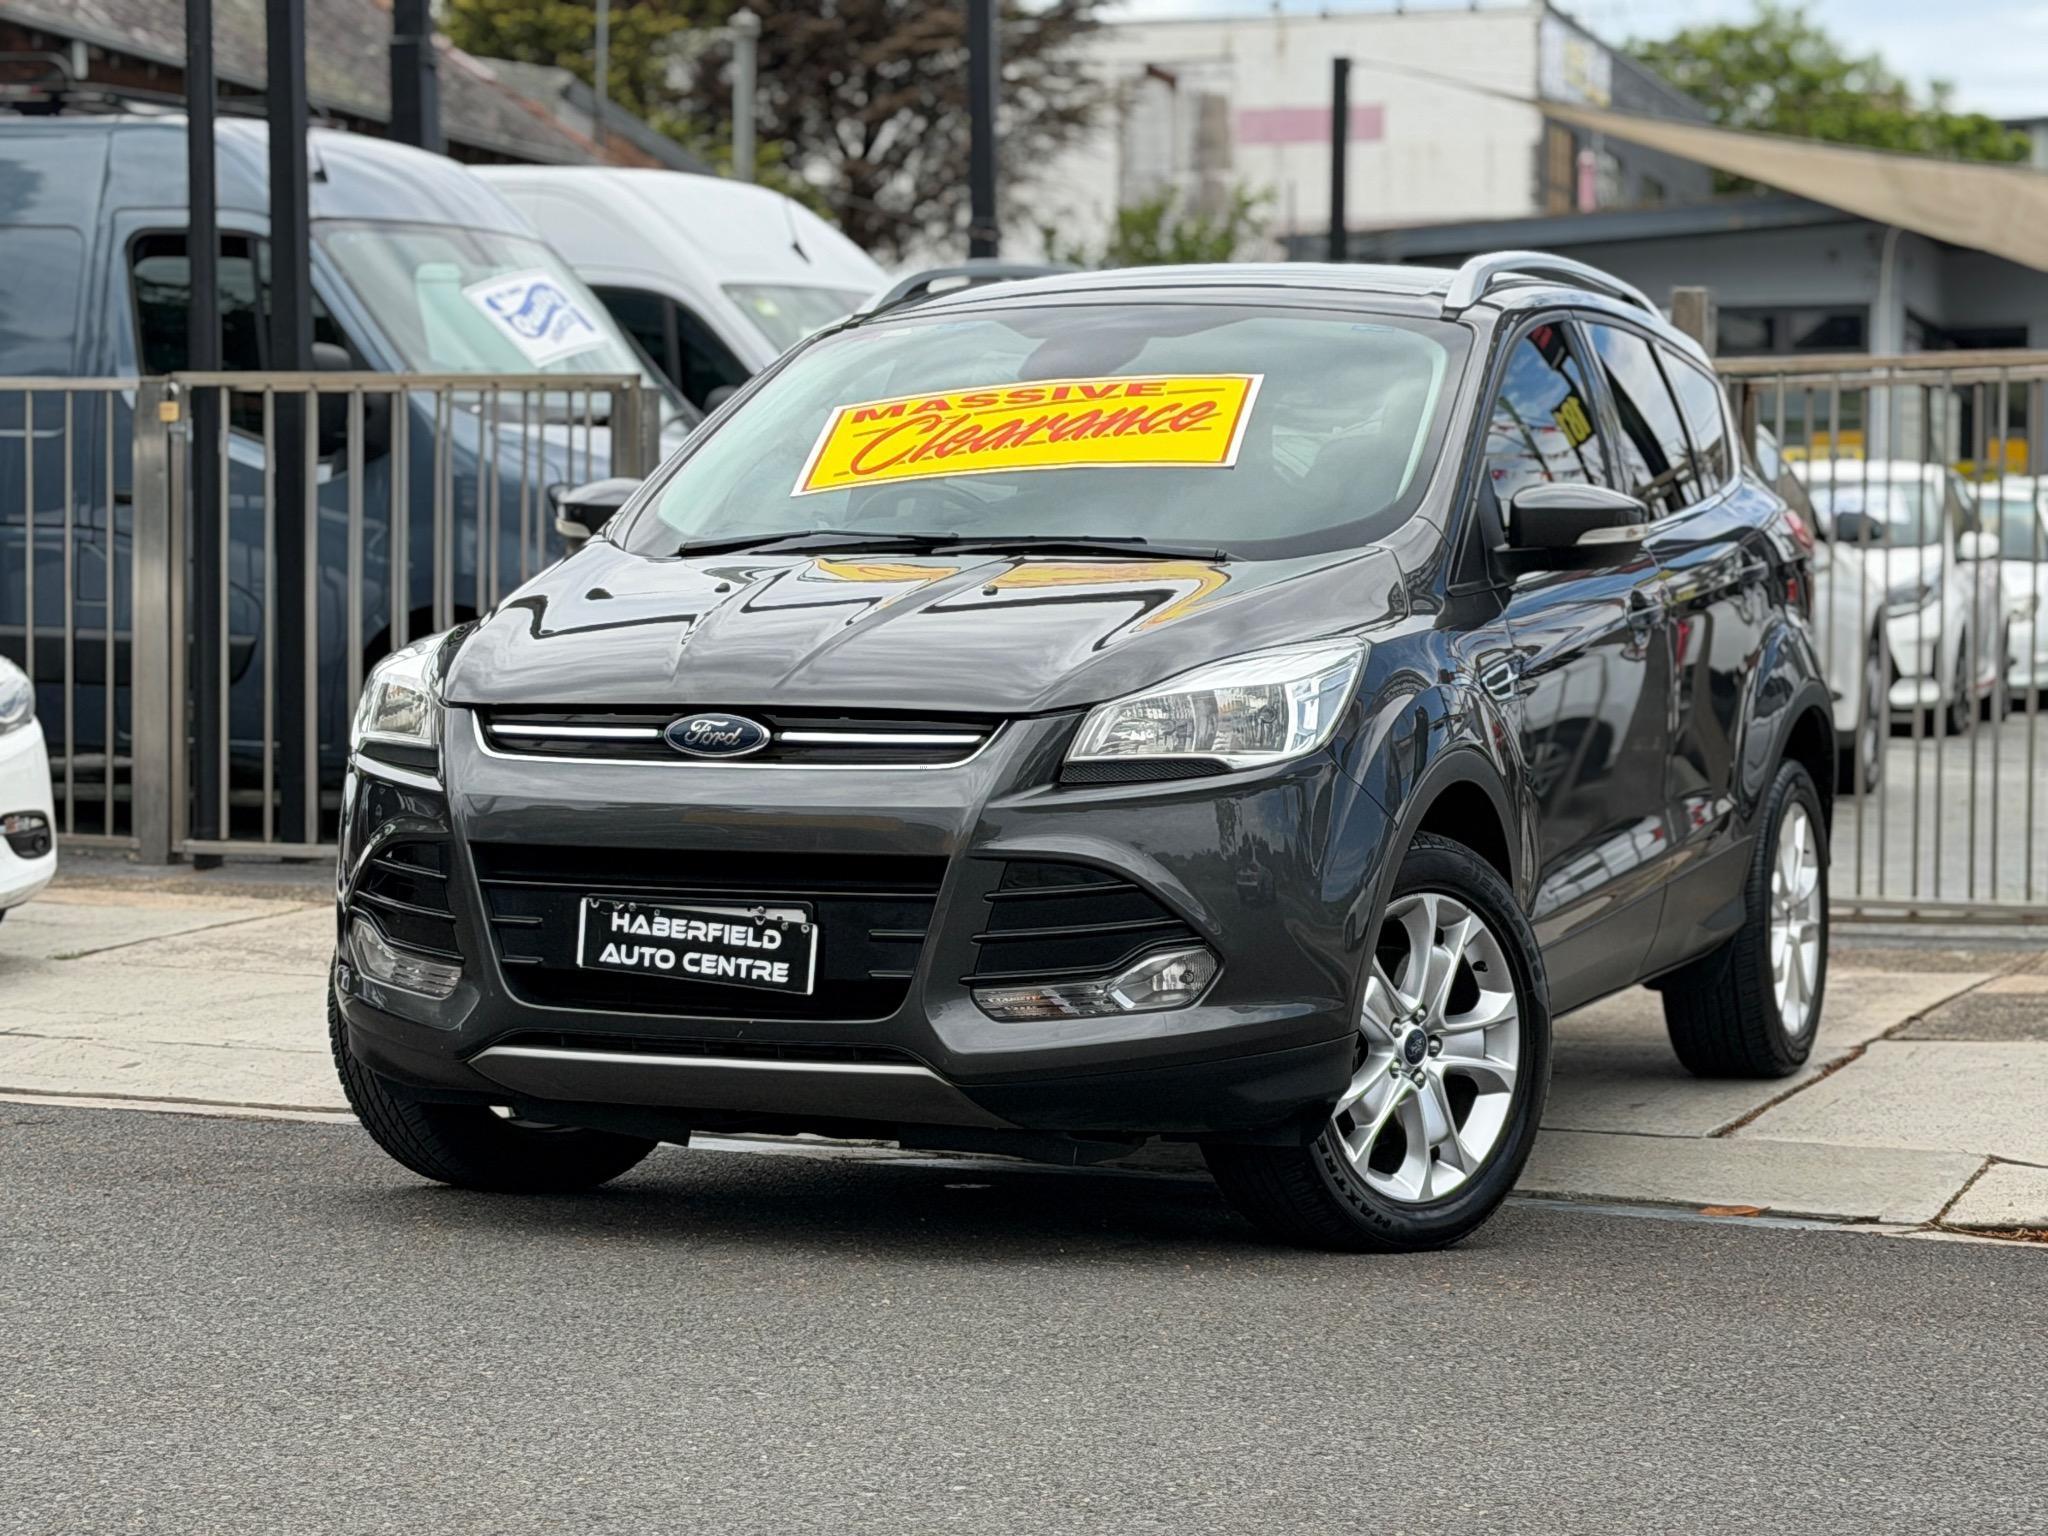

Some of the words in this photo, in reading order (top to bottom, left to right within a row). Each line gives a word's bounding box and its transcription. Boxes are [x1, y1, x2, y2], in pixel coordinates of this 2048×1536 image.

[851, 382, 1167, 423] MASSIVE
[850, 401, 1217, 475] Clearance
[684, 719, 743, 746] Ford
[611, 911, 782, 950] HABERFIELD
[599, 943, 676, 969] AUTO
[682, 952, 790, 983] CENTRE
